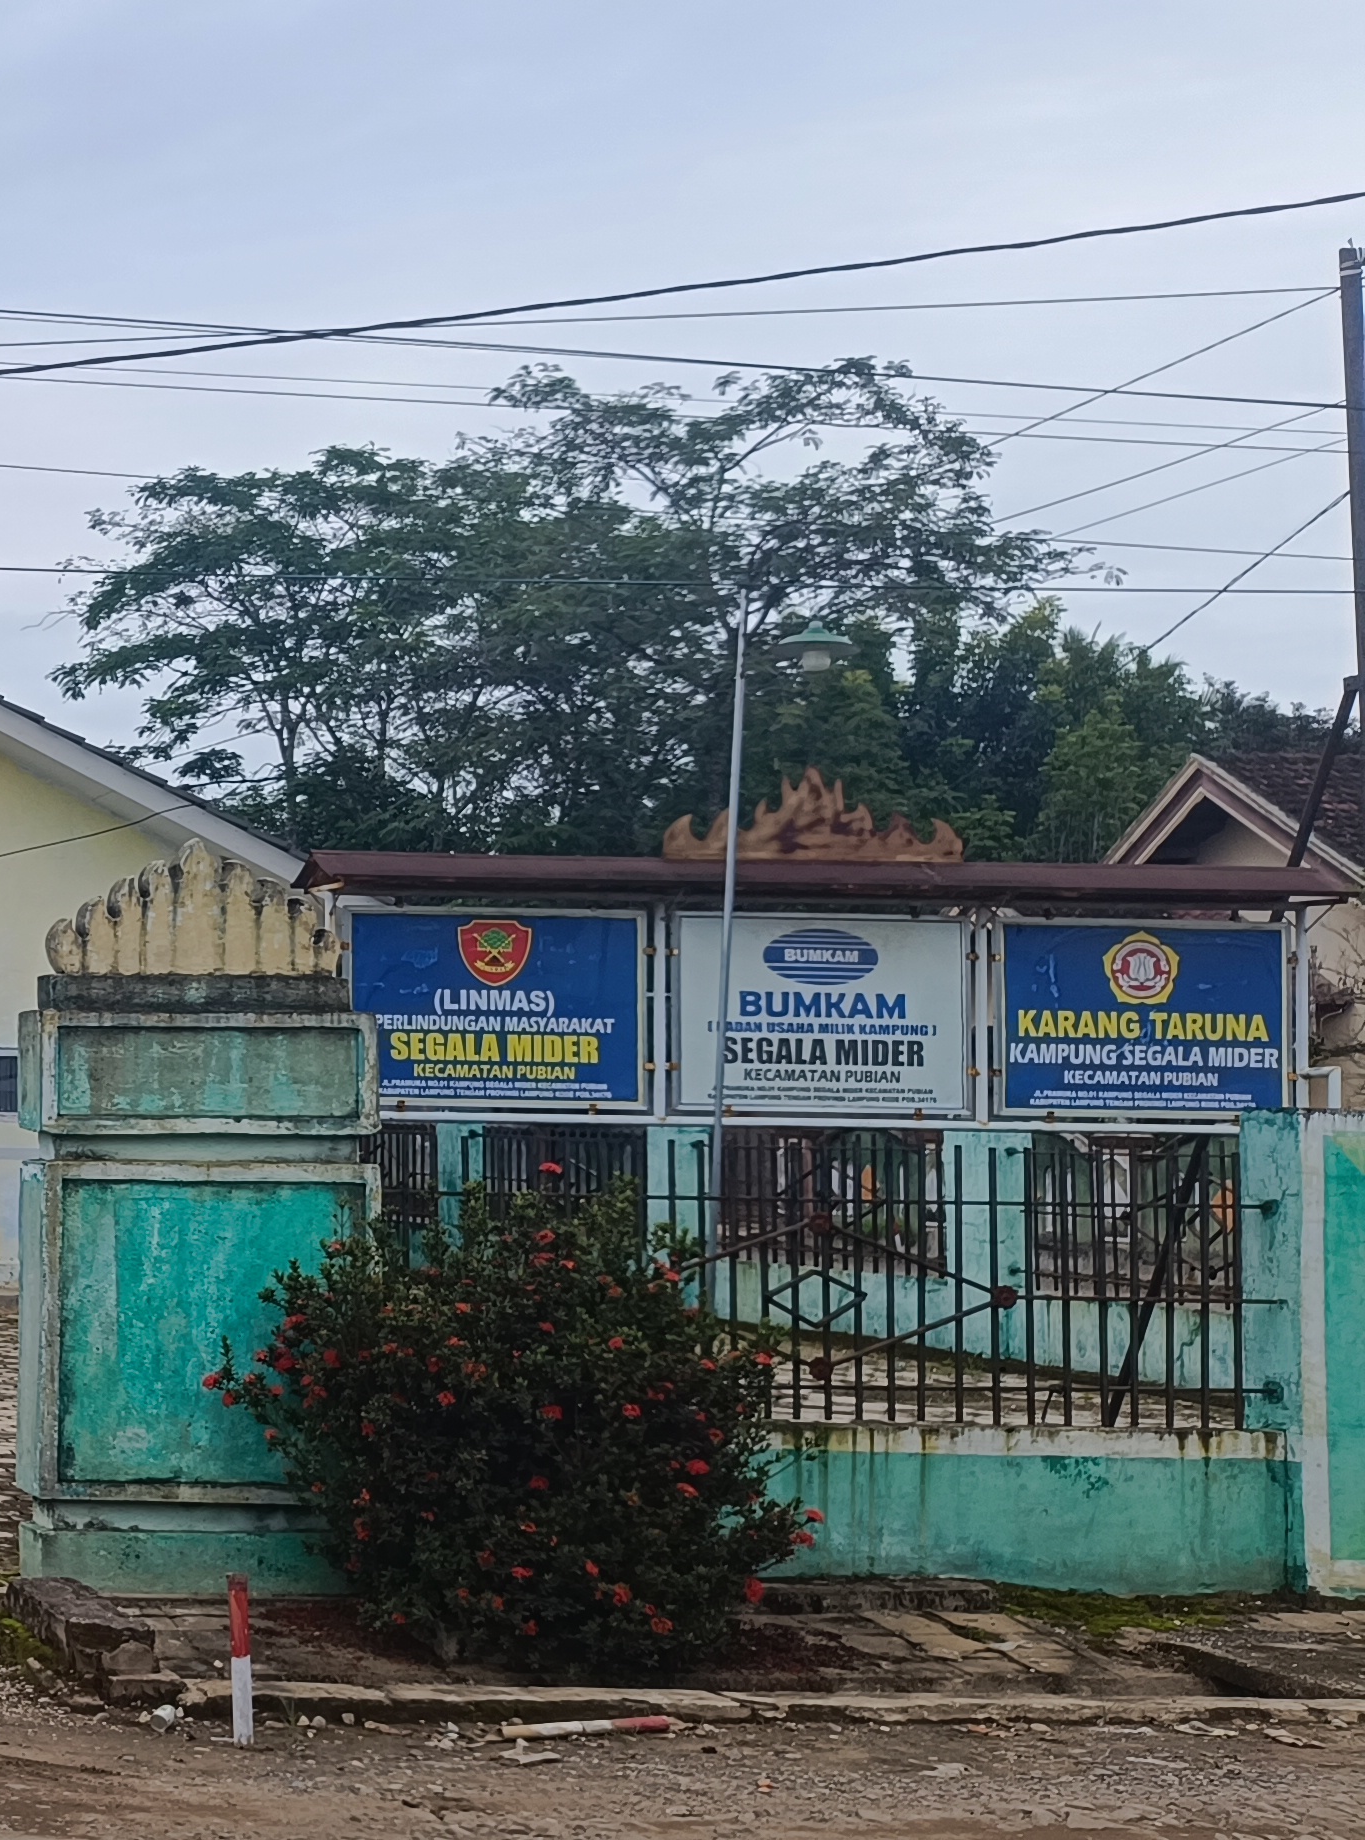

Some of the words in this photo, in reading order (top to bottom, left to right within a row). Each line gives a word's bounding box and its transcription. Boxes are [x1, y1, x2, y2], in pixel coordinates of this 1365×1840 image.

[784, 948, 859, 962] BUMKAM
[434, 988, 554, 1016] (LINMAS)
[739, 991, 906, 1020] BUMKAM
[376, 1014, 500, 1031] PERLINDUNGAN
[504, 1017, 615, 1033] MASYARAKAT
[766, 1022, 814, 1034] USAHA
[818, 1024, 854, 1034] MILIK
[859, 1024, 928, 1036] KAMPUNG
[1018, 1010, 1140, 1038] KARANG
[1150, 1012, 1269, 1041] TARUNA
[390, 1032, 500, 1062] SEGALA
[507, 1034, 599, 1063] MIDER
[724, 1037, 828, 1065] SEGALA
[835, 1039, 924, 1067] MIDER
[1010, 1042, 1116, 1064] KAMPUNG
[1122, 1044, 1203, 1067] SEGALA
[1208, 1047, 1279, 1068] MIDER
[414, 1064, 513, 1078] KECAMATAN
[517, 1066, 575, 1080] PUBIAN
[744, 1068, 841, 1082] KECAMATAN
[845, 1070, 901, 1084] PUBIAN
[1064, 1070, 1160, 1086] KECAMATAN
[1164, 1071, 1218, 1086] PUBIAN
